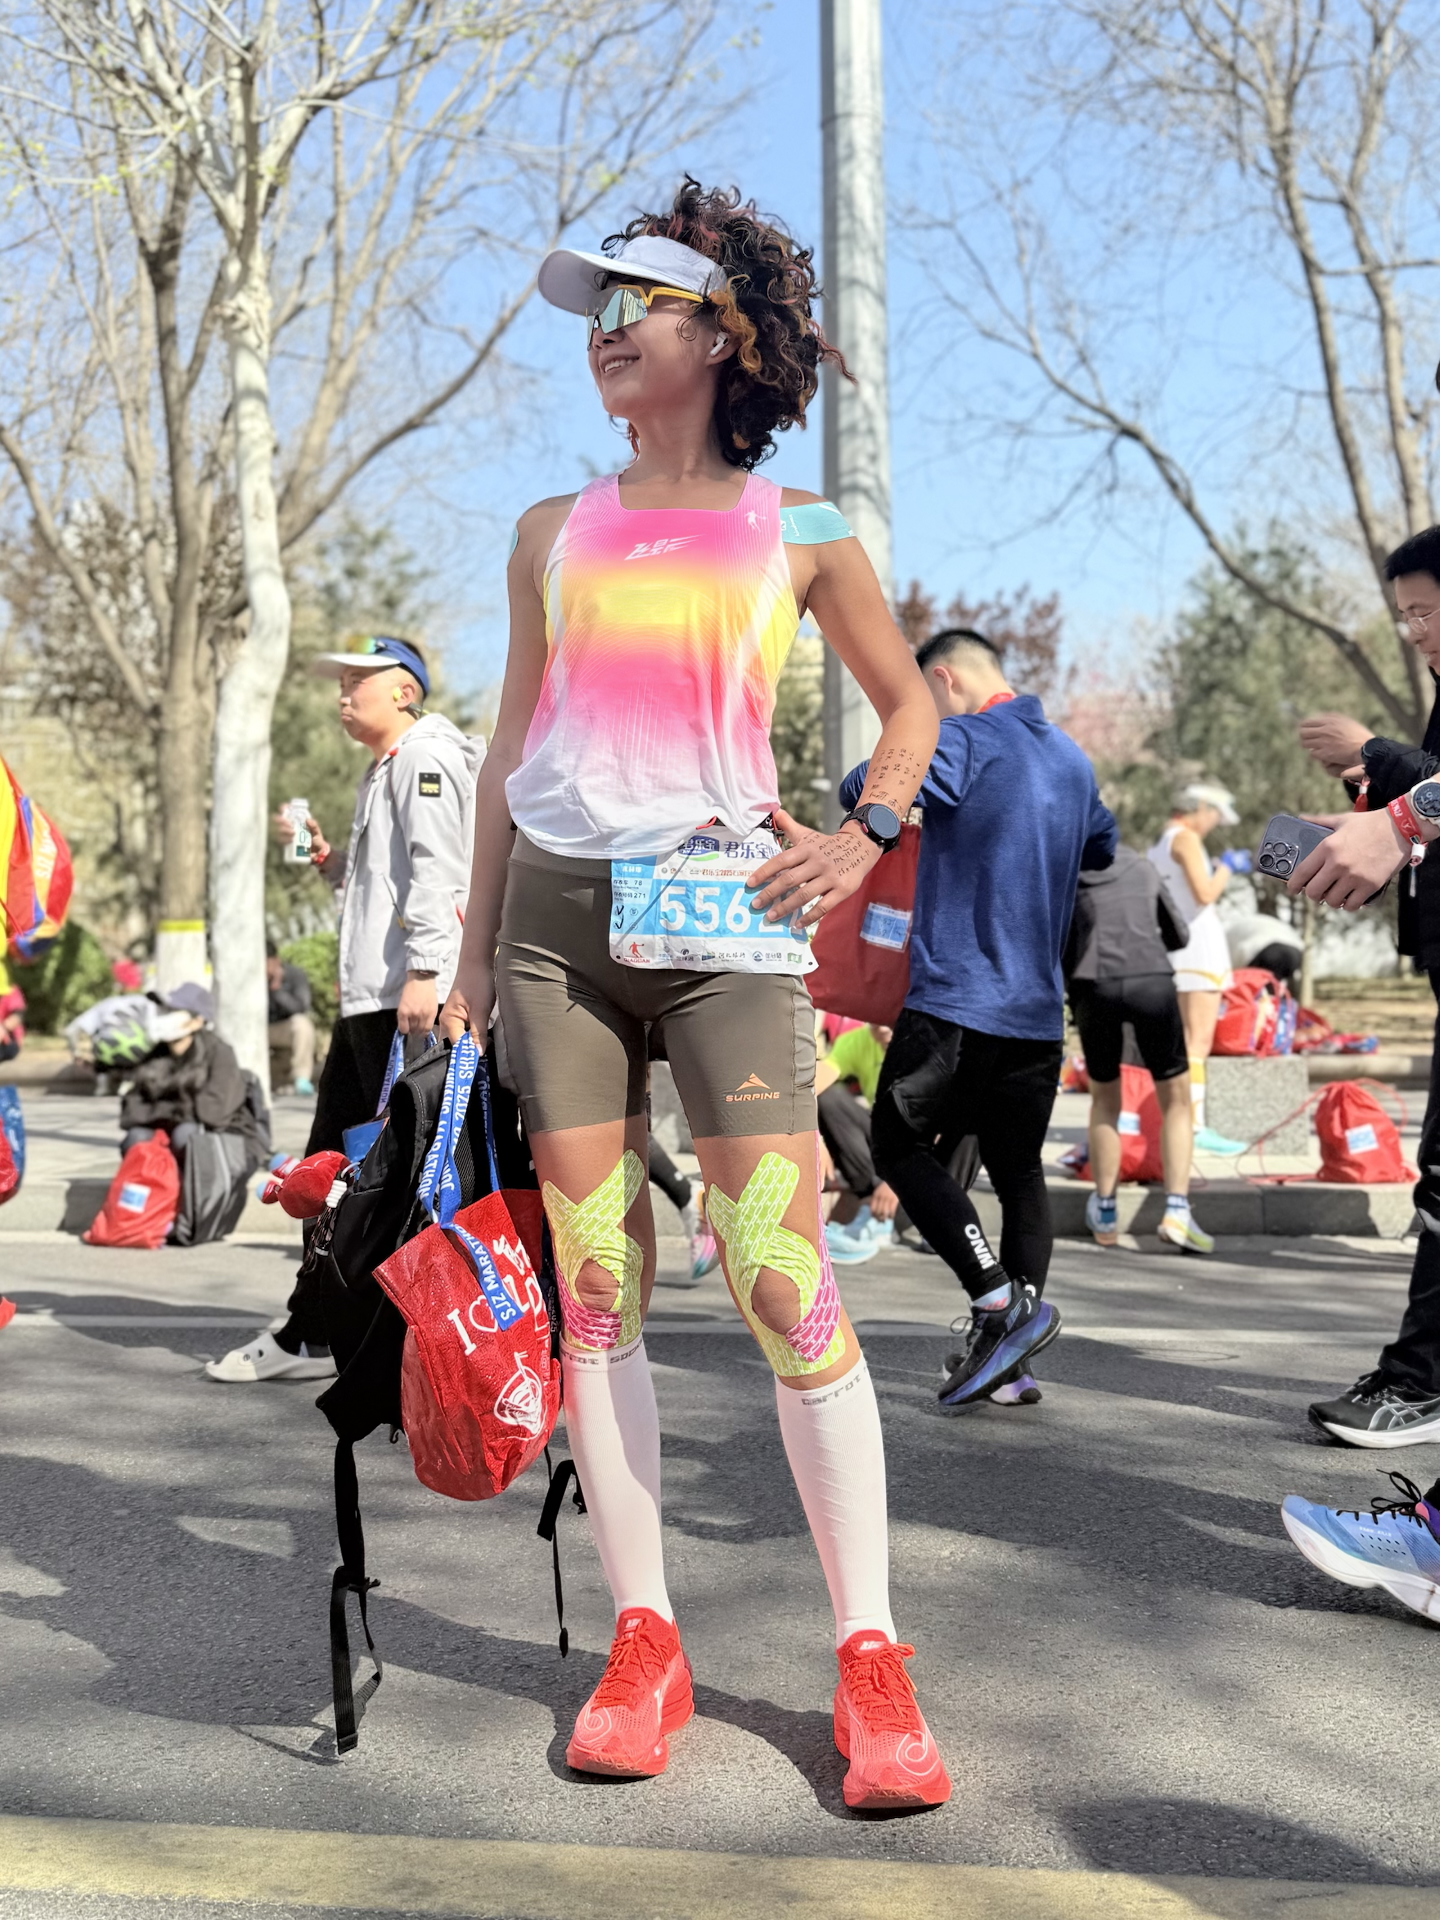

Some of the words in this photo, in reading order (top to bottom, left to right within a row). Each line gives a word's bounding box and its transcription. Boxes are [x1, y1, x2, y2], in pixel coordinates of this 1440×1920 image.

[659, 884, 804, 937] 556
[725, 1091, 780, 1102] SURPINE
[449, 1223, 499, 1291] MARATHO
[491, 1292, 516, 1321] SJZ
